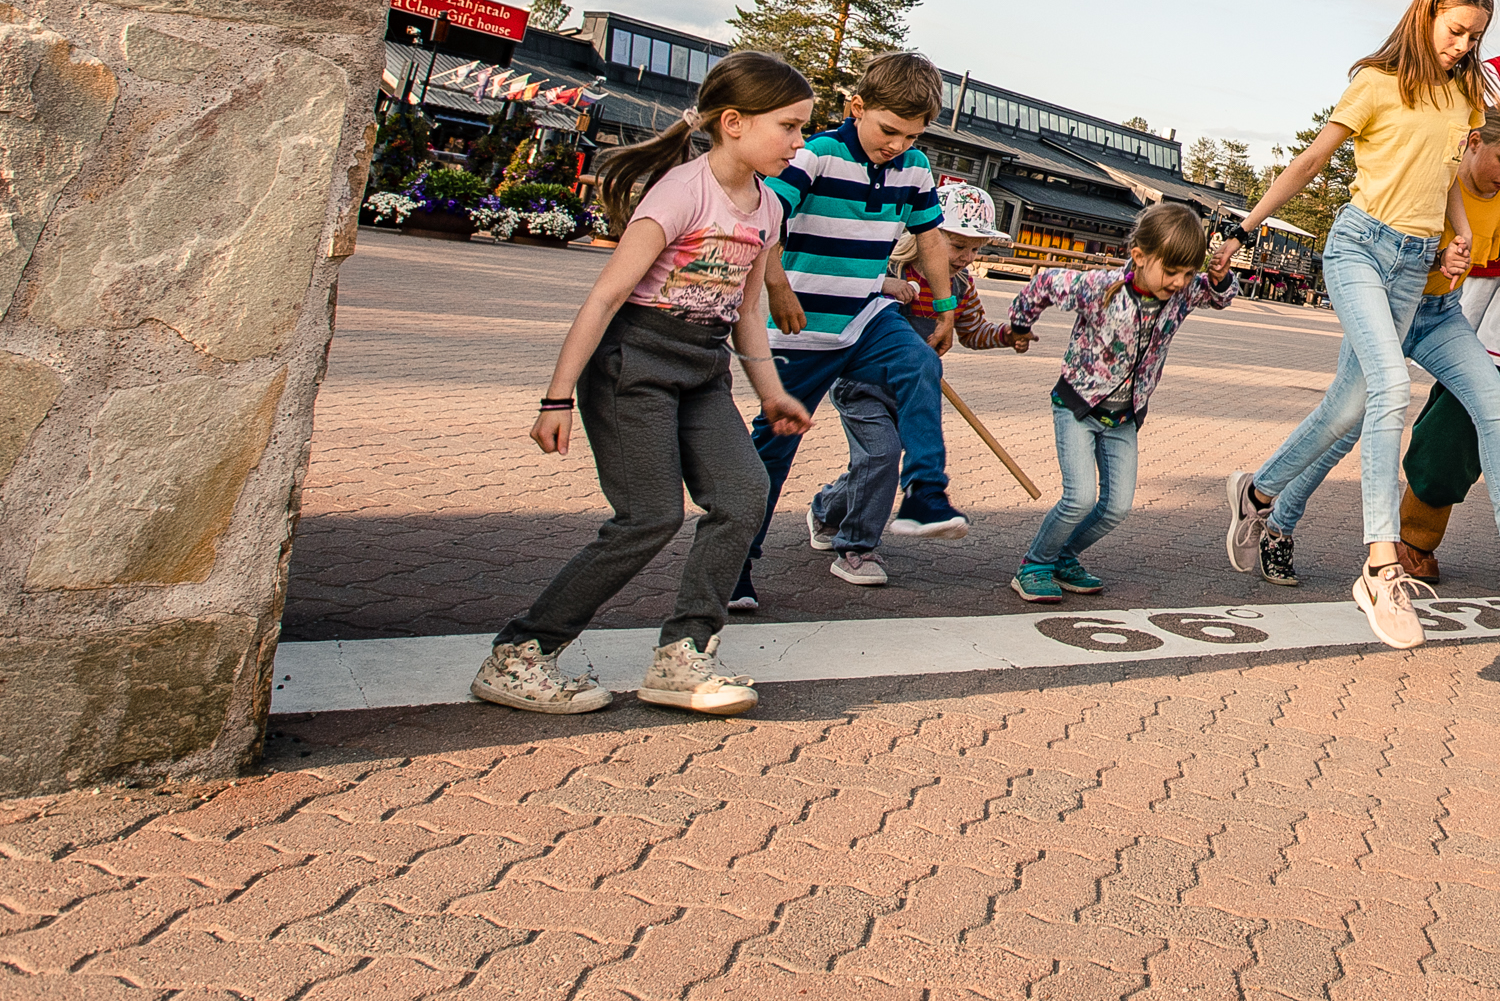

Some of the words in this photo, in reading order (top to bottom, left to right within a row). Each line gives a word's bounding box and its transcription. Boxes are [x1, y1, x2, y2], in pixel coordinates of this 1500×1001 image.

[446, 8, 475, 27] Gift
[476, 16, 512, 36] house
[1034, 608, 1270, 653] 66°
